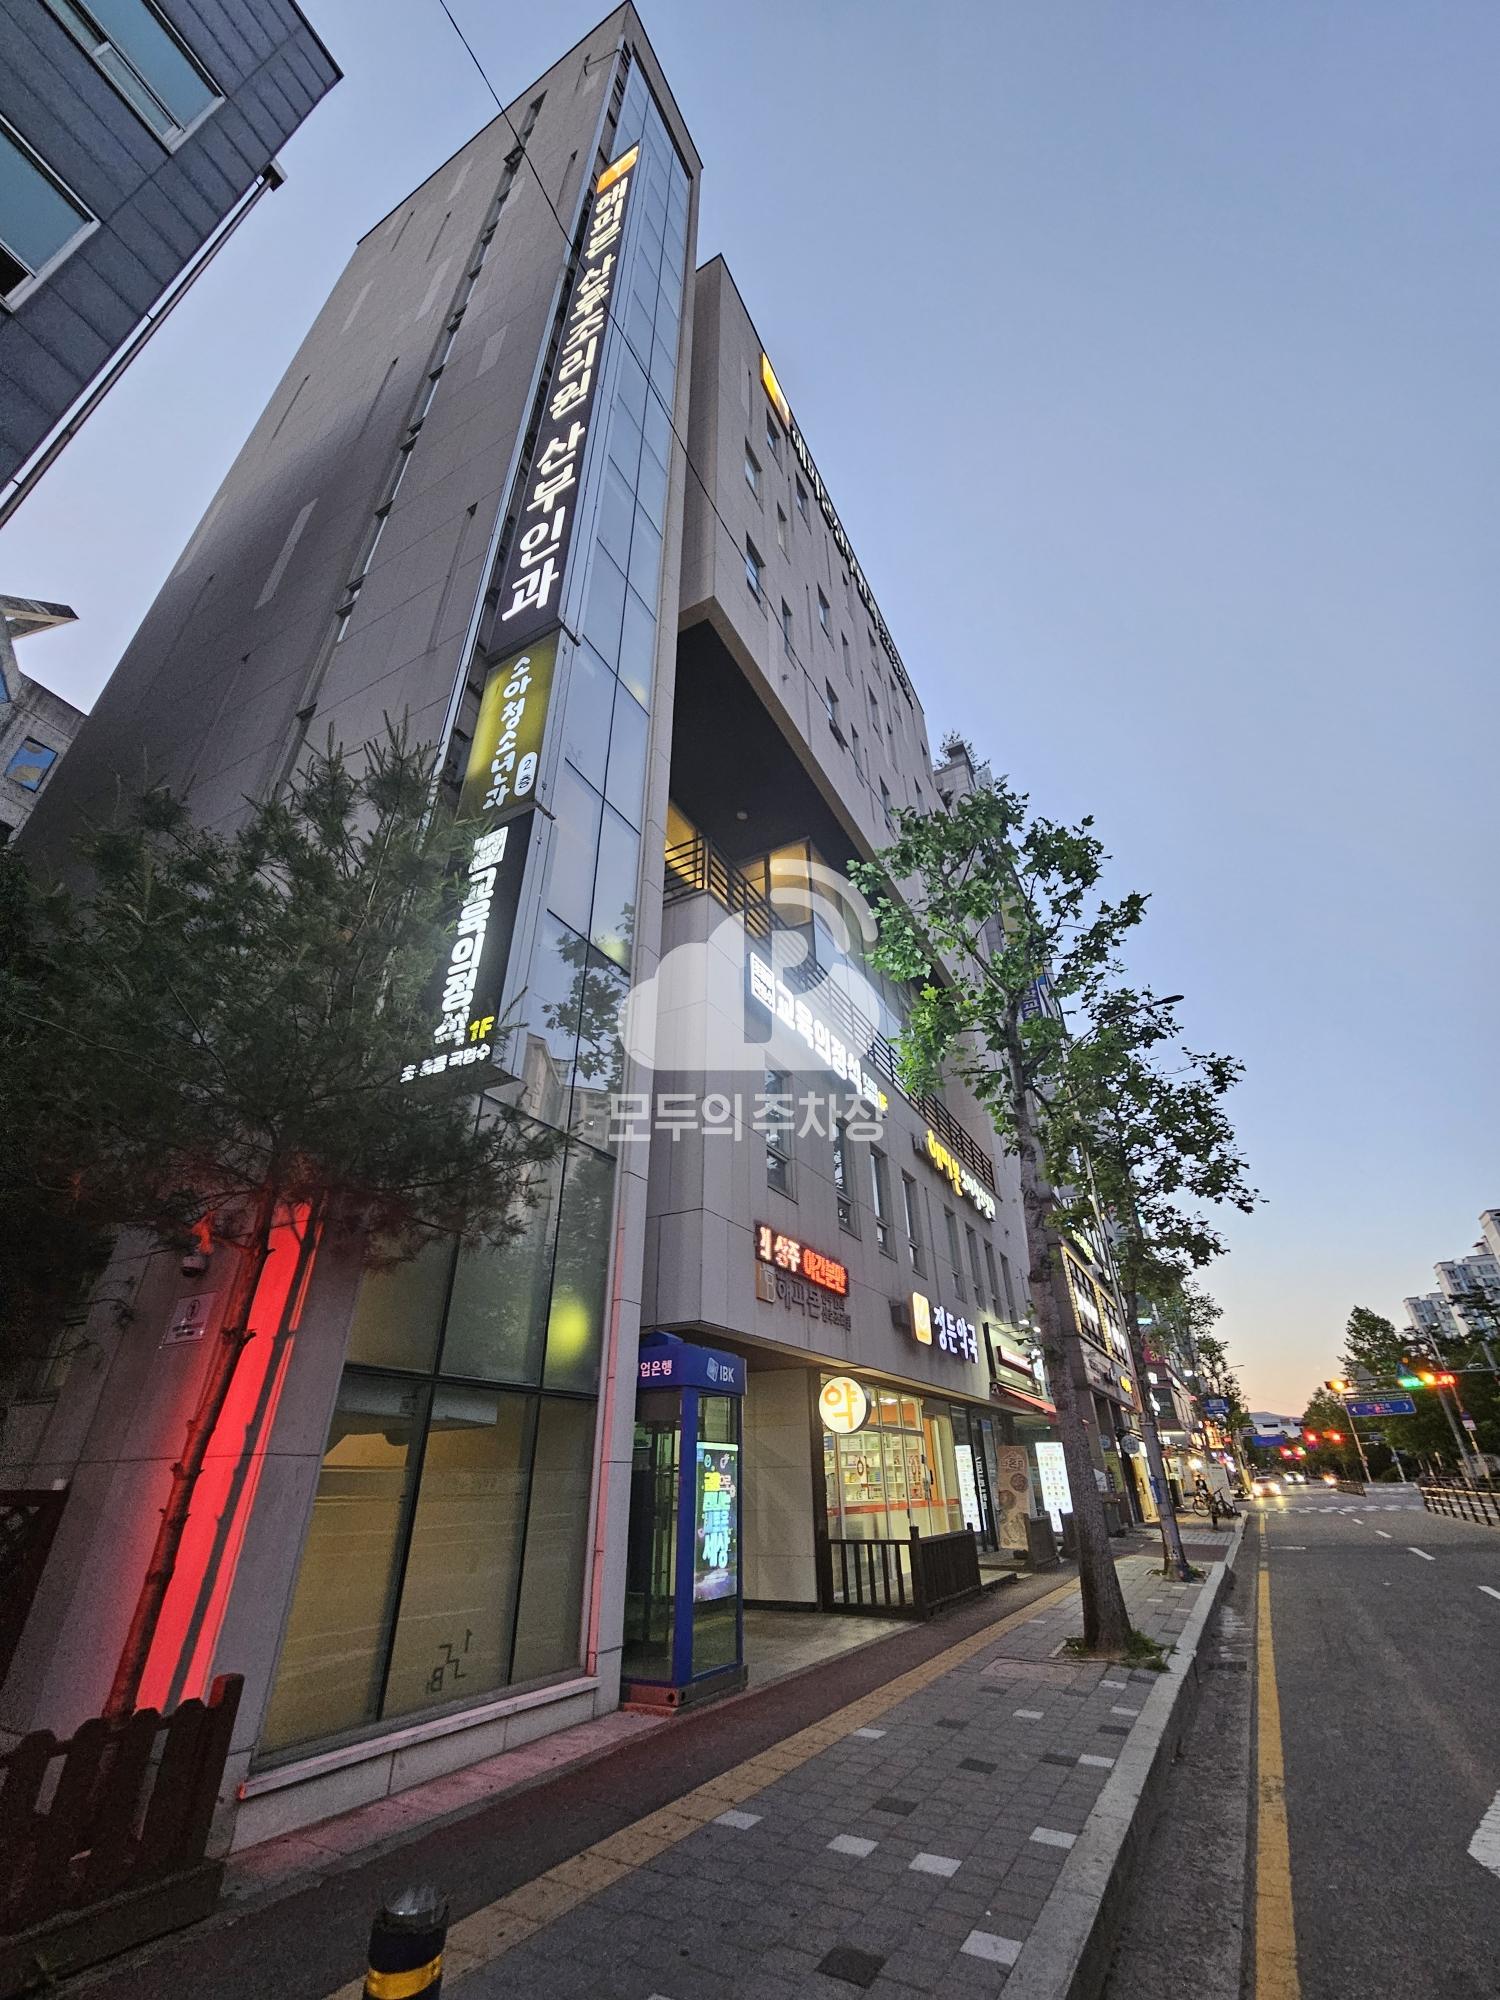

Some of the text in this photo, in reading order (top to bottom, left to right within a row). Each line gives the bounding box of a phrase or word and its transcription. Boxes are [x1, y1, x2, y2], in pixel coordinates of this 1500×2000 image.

[549, 253, 616, 421] 산후조리원
[501, 421, 586, 623] 산부인과
[482, 656, 532, 810] 소아청소년과
[433, 866, 498, 1047] 교육의정석
[469, 1015, 495, 1042] 1F
[719, 1364, 735, 1383] IBK
[933, 1305, 979, 1364] 정든약국
[823, 1381, 859, 1430] 약
